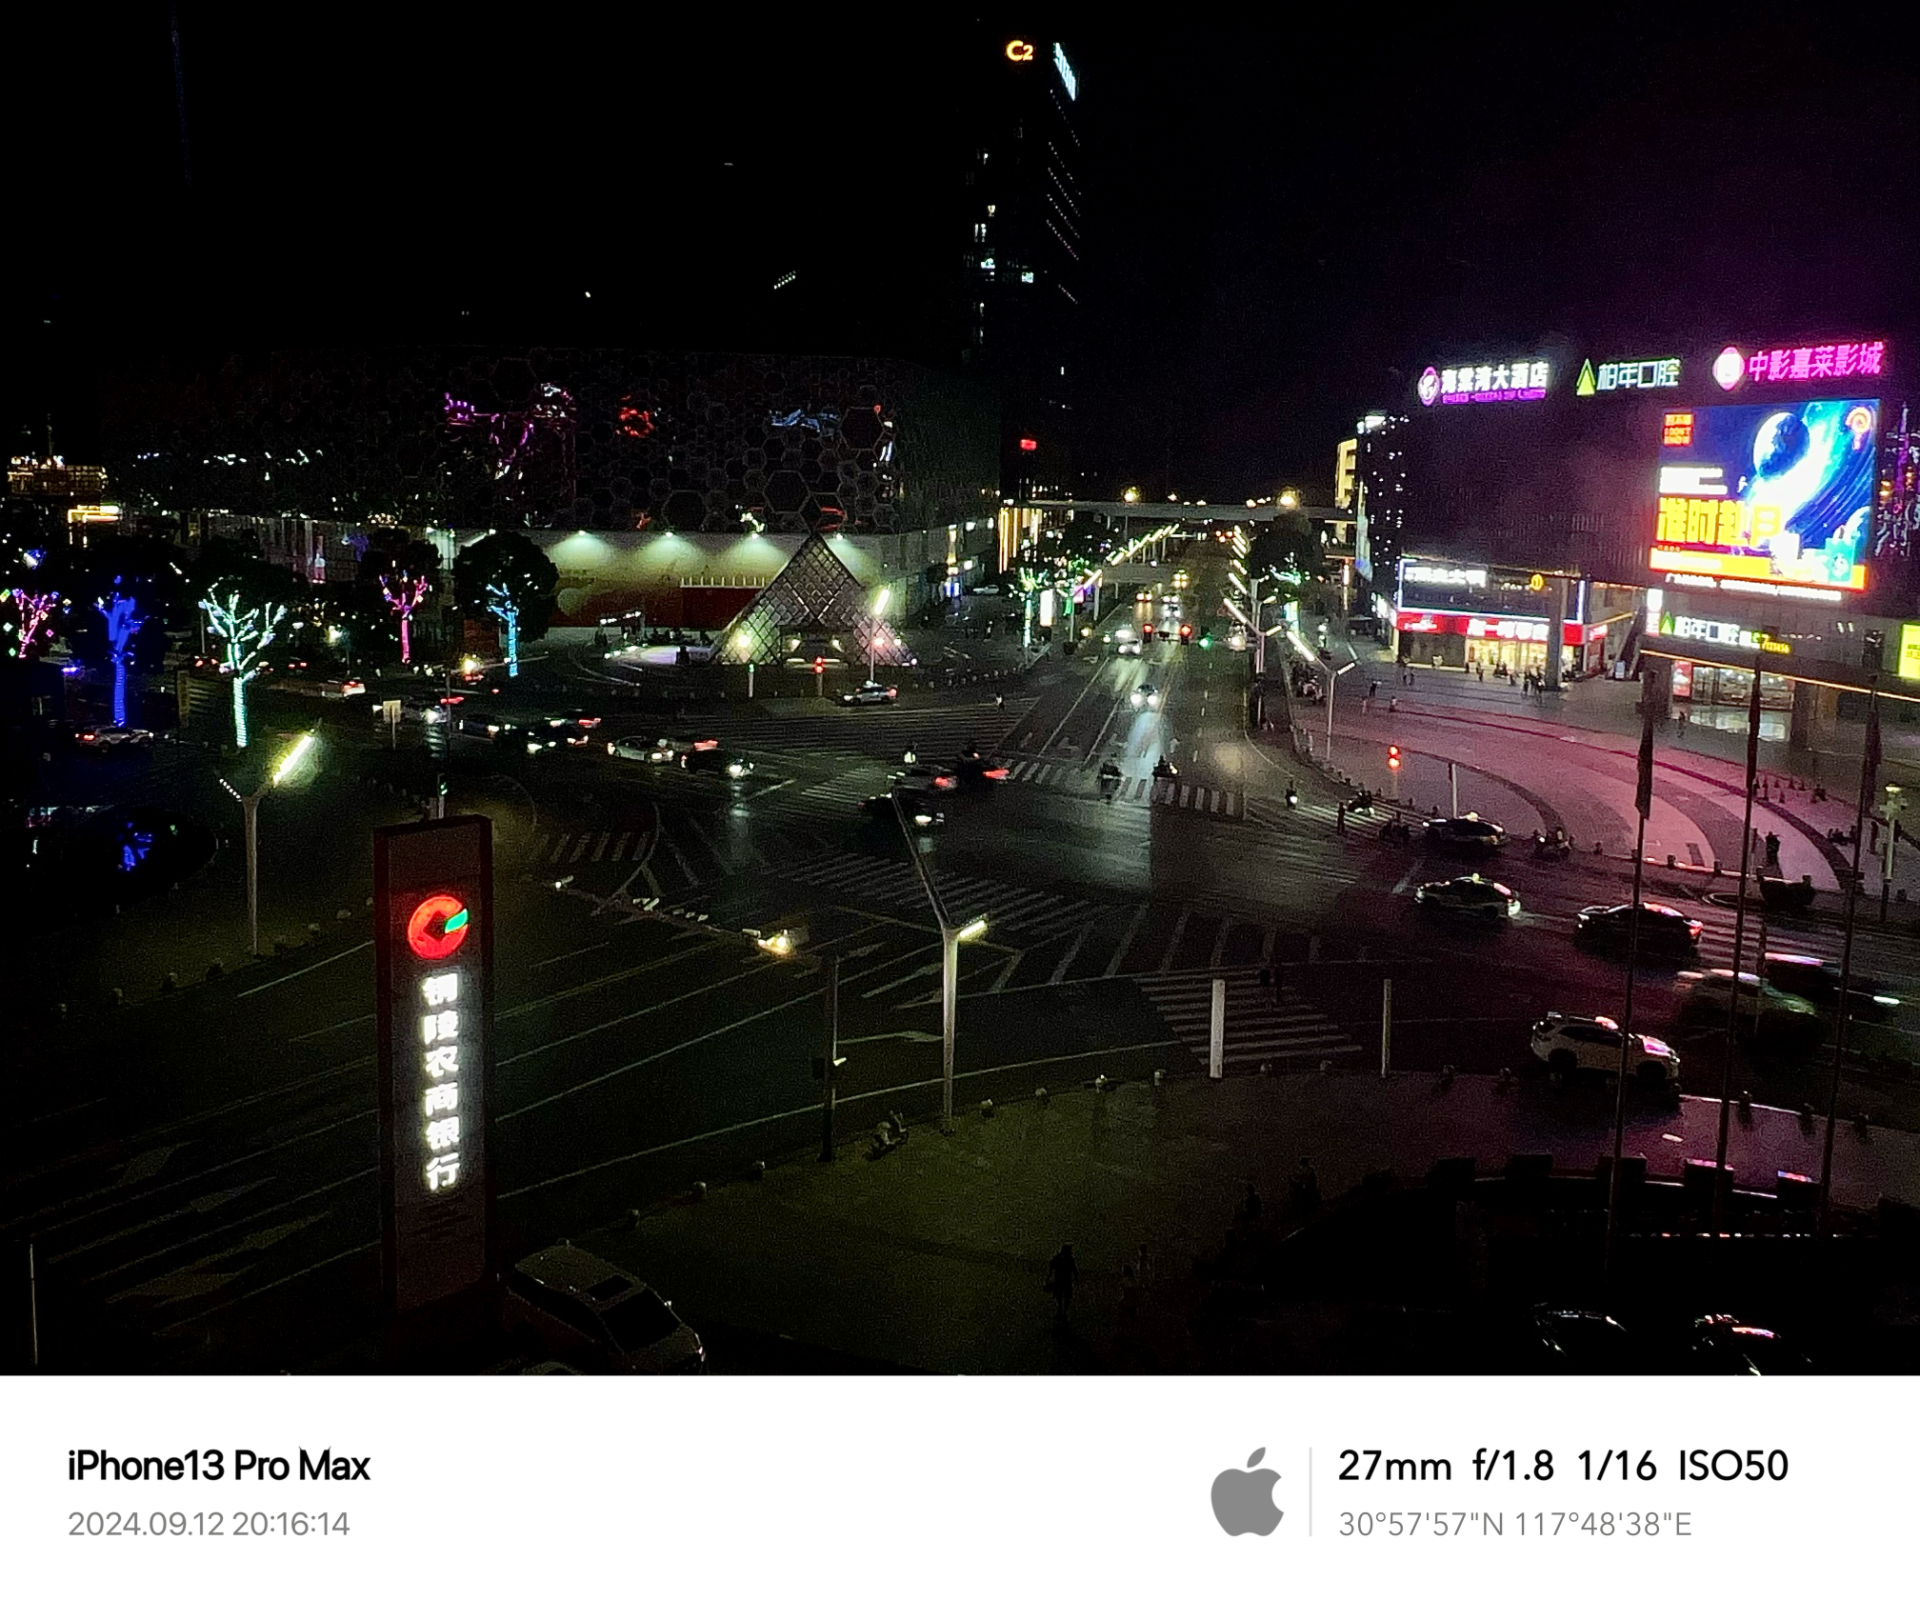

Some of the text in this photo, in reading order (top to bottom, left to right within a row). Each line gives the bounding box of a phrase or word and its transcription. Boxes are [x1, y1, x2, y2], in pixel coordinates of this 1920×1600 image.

[1006, 40, 1034, 62] C2
[1597, 358, 1681, 391] 柏年口腔
[1749, 341, 1884, 382] 中影嘉莱影城
[421, 973, 460, 1192] 铜陵农商银行
